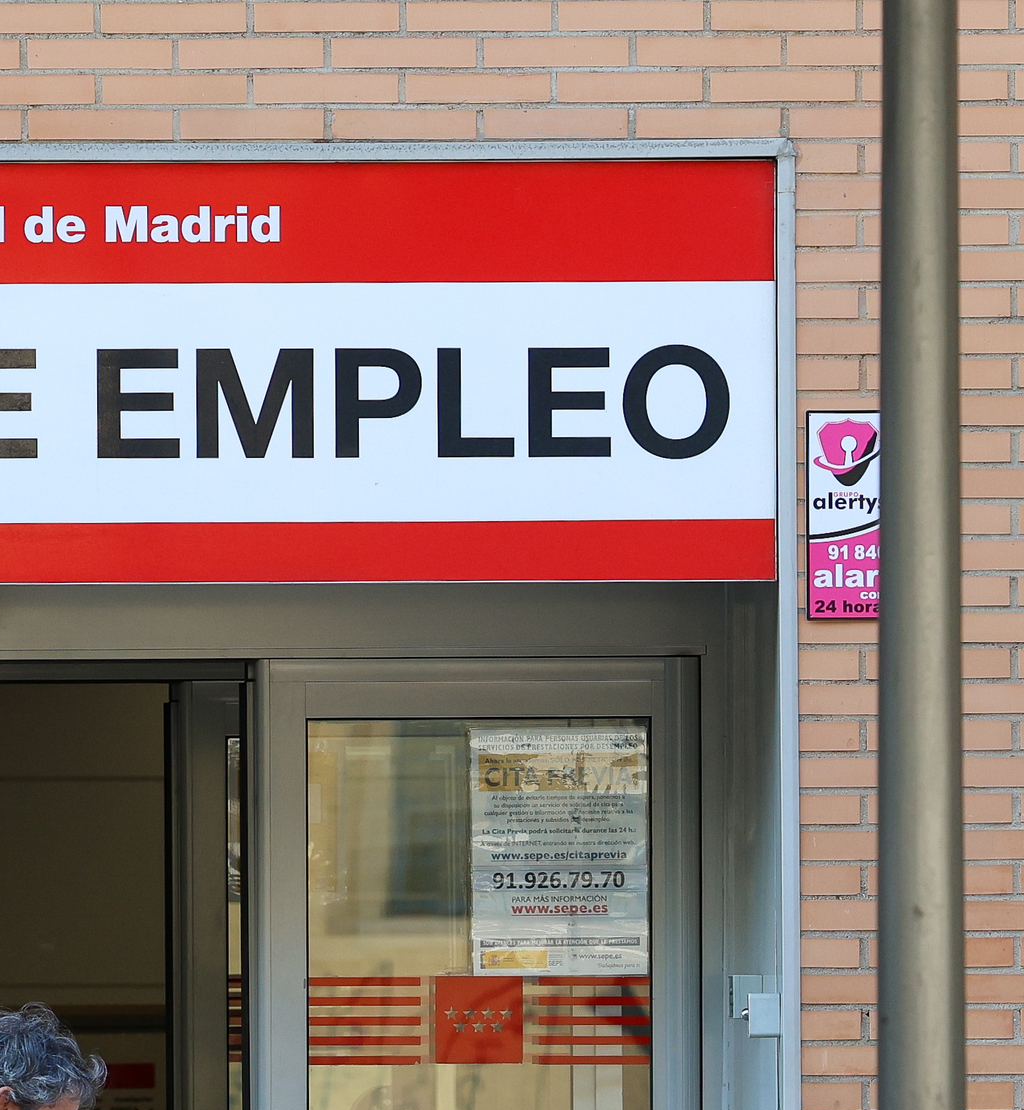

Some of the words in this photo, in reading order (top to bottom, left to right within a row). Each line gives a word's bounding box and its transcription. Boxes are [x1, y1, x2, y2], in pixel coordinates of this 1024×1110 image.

[24, 206, 85, 243] de
[106, 206, 280, 242] Madrid
[97, 345, 730, 459] EMPLEO
[828, 545, 849, 560] 91
[854, 545, 880, 560] 84
[815, 600, 837, 613] 24
[478, 734, 524, 742] INFORMACIÓN
[485, 767, 540, 787] CITA
[491, 850, 627, 861] www.sepe.es/citaprevia
[493, 871, 625, 889] 91.926.79.70
[533, 894, 549, 903] MÁS
[551, 894, 607, 902] INFORMACIÓN
[512, 903, 608, 914] www.sepe.es
